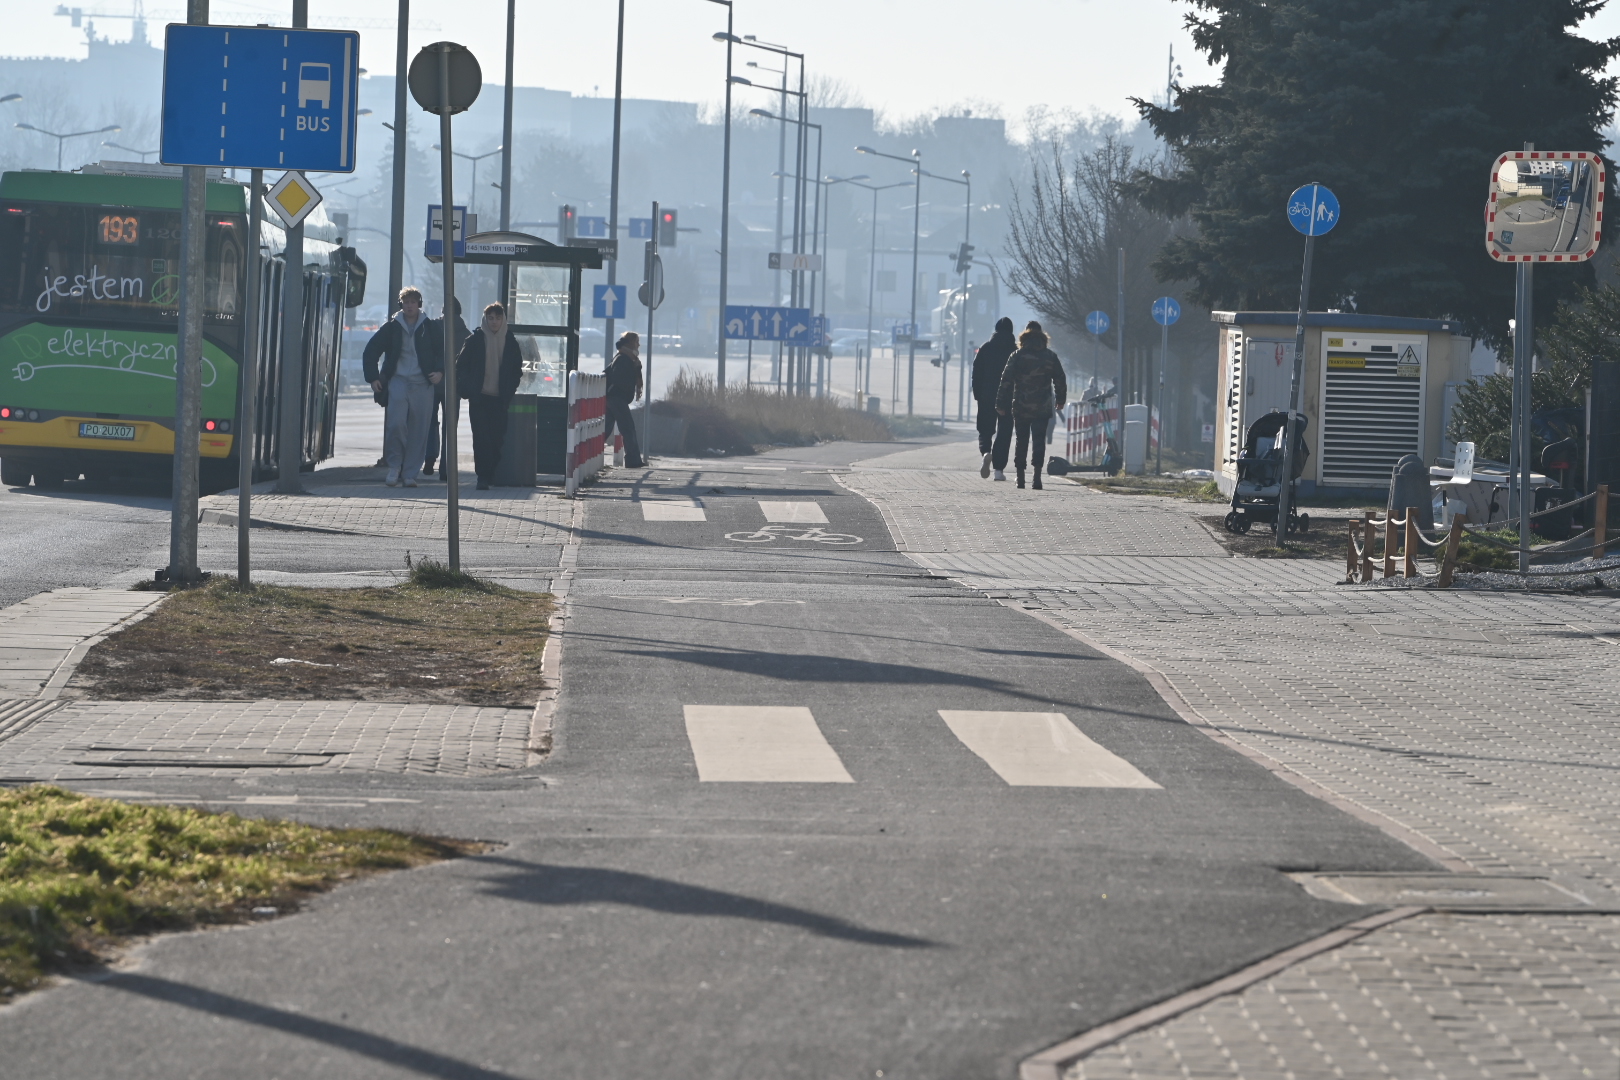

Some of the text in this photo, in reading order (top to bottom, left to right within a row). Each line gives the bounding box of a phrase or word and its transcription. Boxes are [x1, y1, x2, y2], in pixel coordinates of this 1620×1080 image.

[296, 115, 330, 132] BUS
[100, 215, 138, 244] 193
[36, 264, 143, 312] jestem
[47, 329, 178, 370] elektryczn
[86, 424, 99, 435] PO
[101, 425, 132, 437] 2UX07
